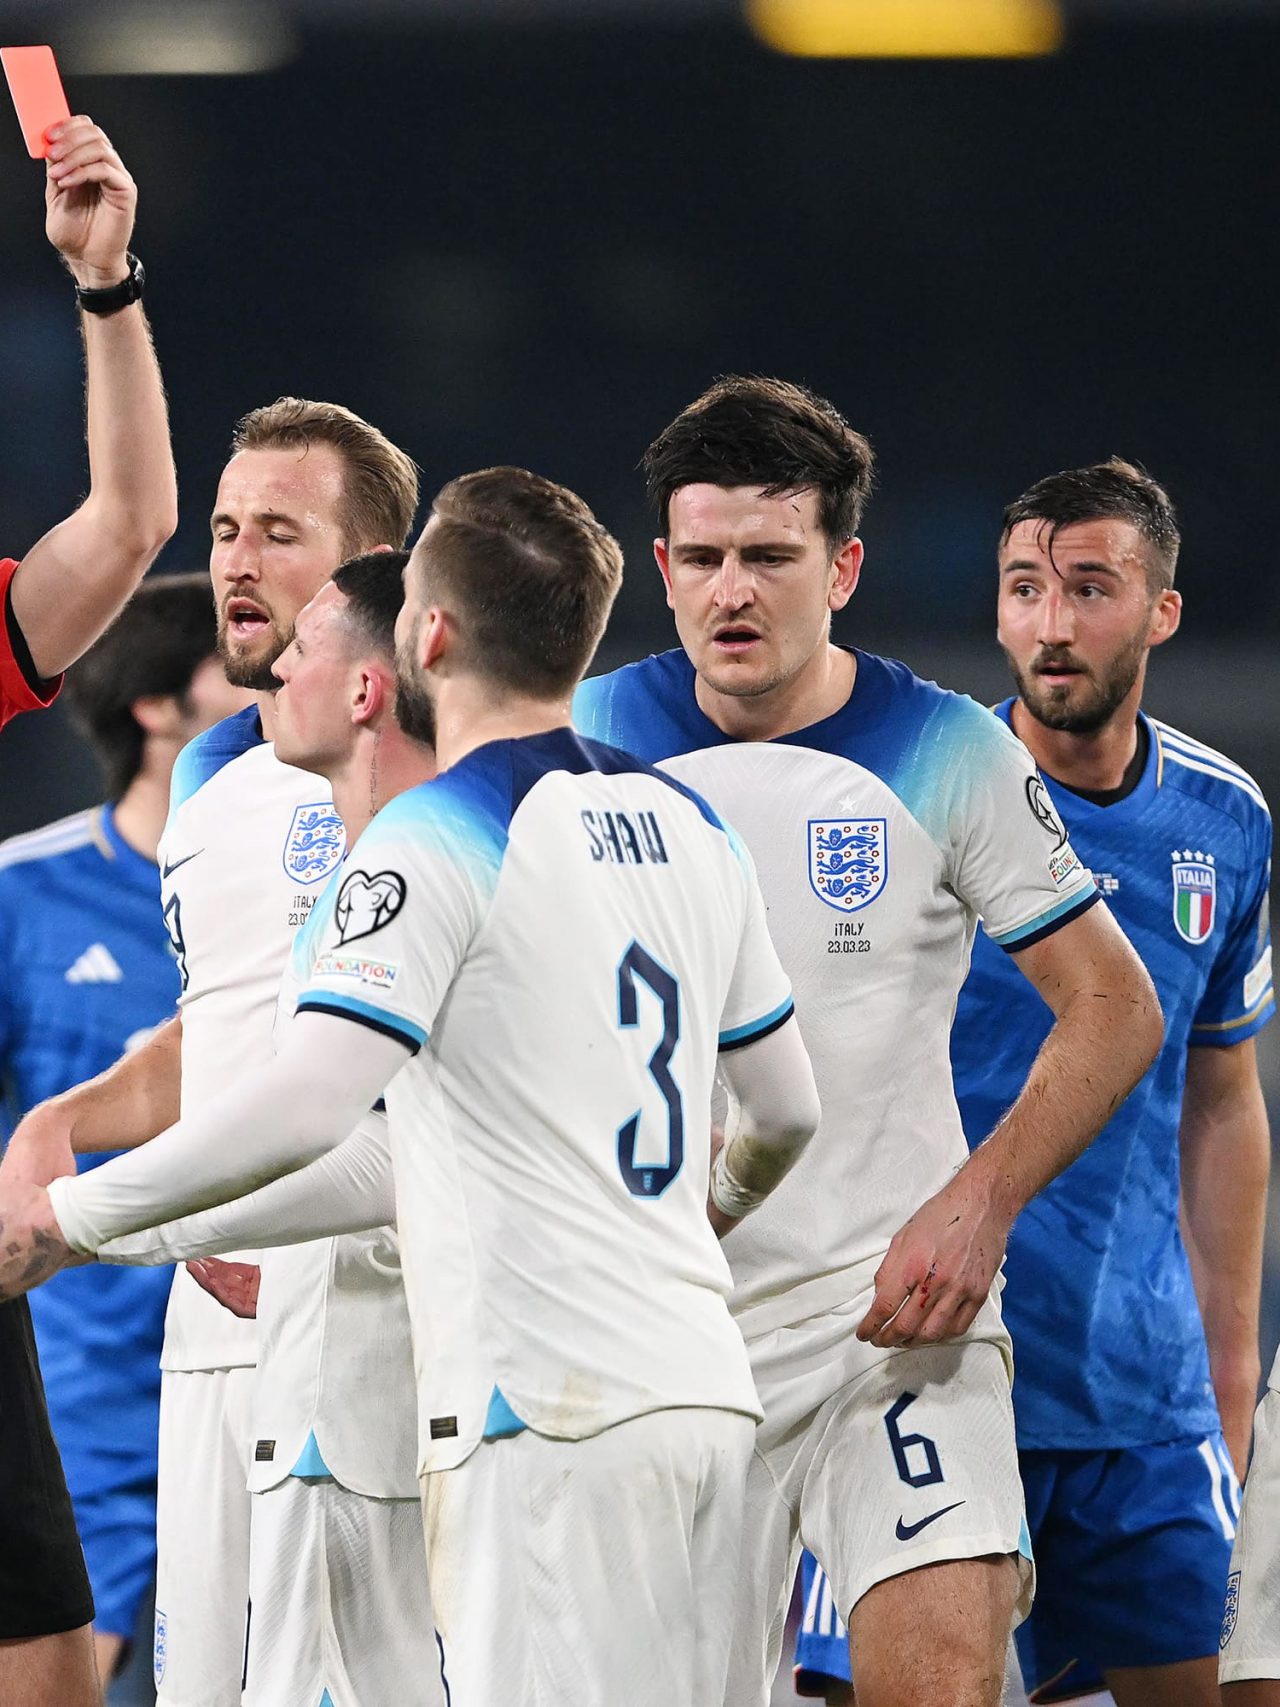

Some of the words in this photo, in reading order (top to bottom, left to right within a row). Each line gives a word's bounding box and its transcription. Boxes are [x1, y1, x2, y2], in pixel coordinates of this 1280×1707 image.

[581, 810, 669, 864] SHAW
[1177, 869, 1212, 888] ITALIA
[827, 940, 871, 954] 23.03.23
[616, 936, 685, 1200] 3
[884, 1391, 945, 1489] 6
